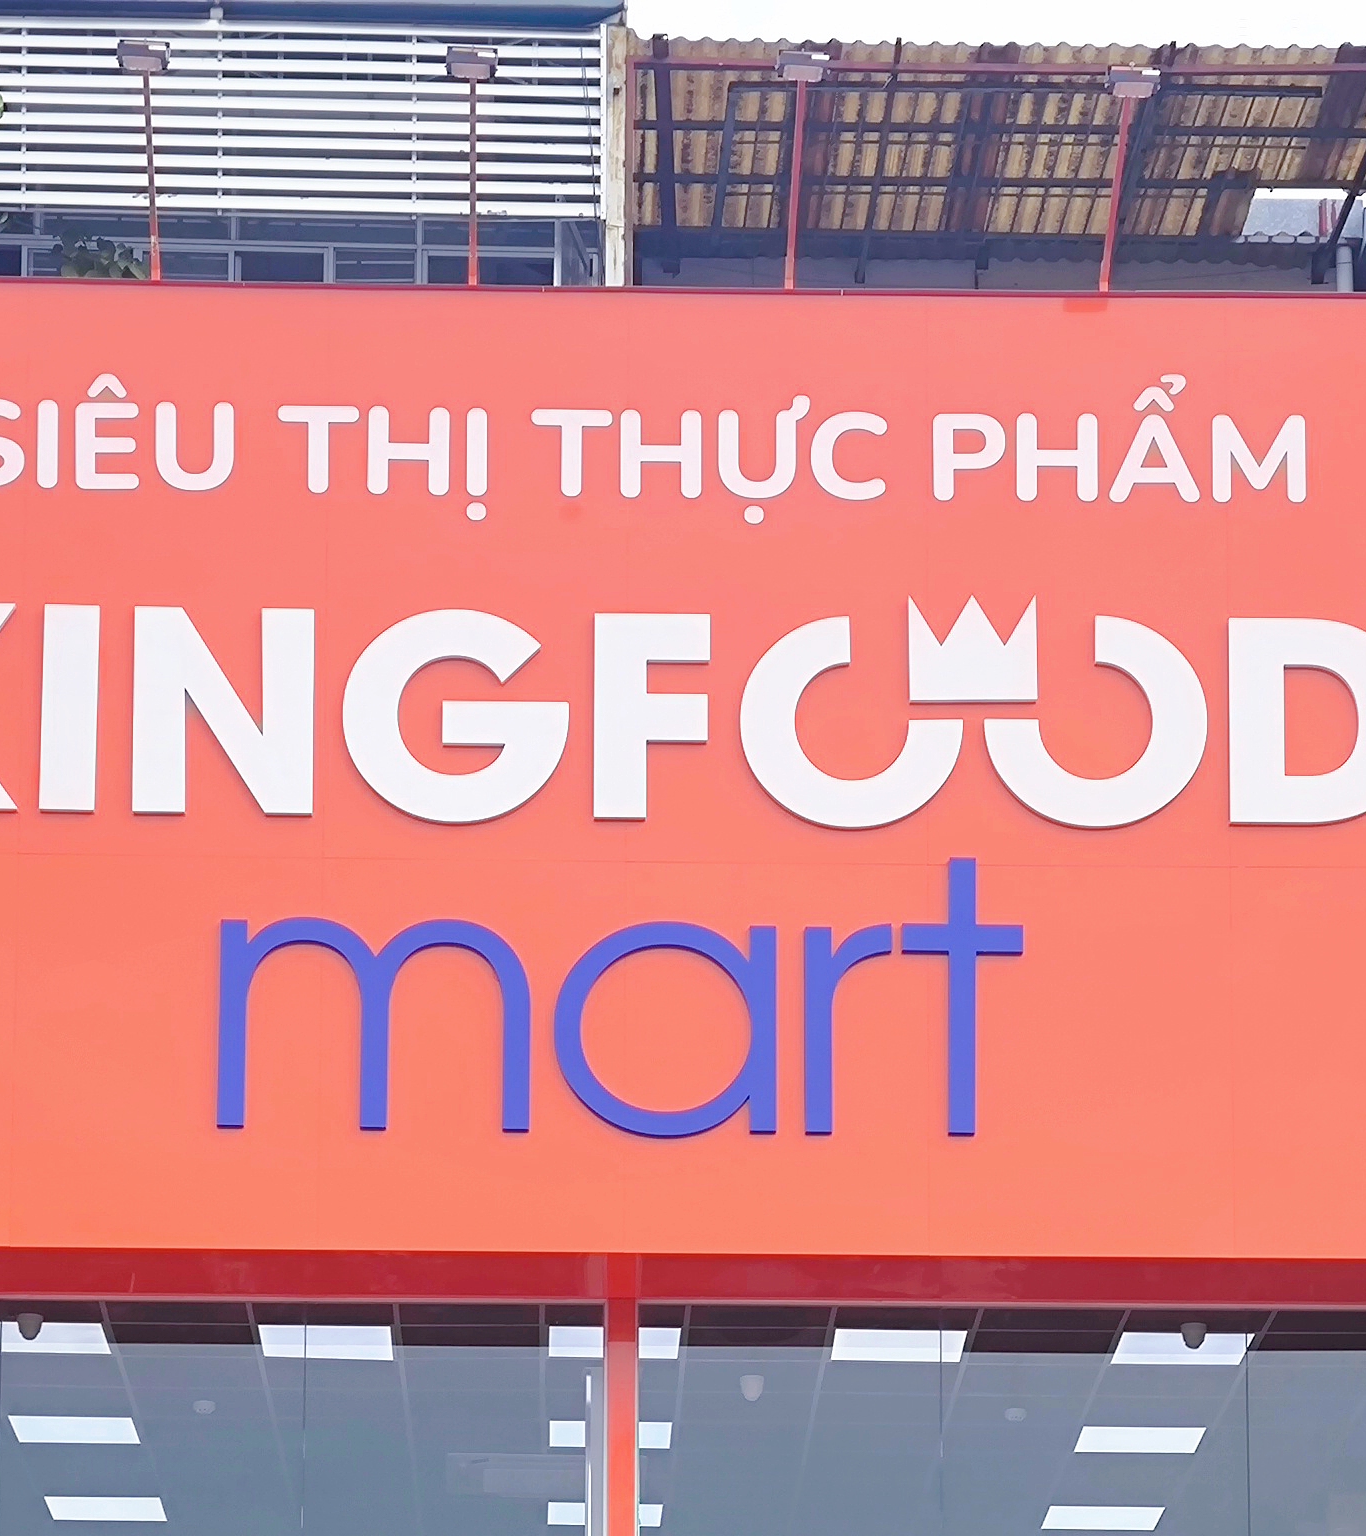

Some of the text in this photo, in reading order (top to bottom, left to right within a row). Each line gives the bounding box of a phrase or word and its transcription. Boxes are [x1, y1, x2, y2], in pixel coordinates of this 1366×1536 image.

[280, 403, 488, 522] THỊ
[533, 394, 888, 525] THỰC
[935, 372, 1308, 505] PHẨM
[216, 856, 1024, 1138] mart
